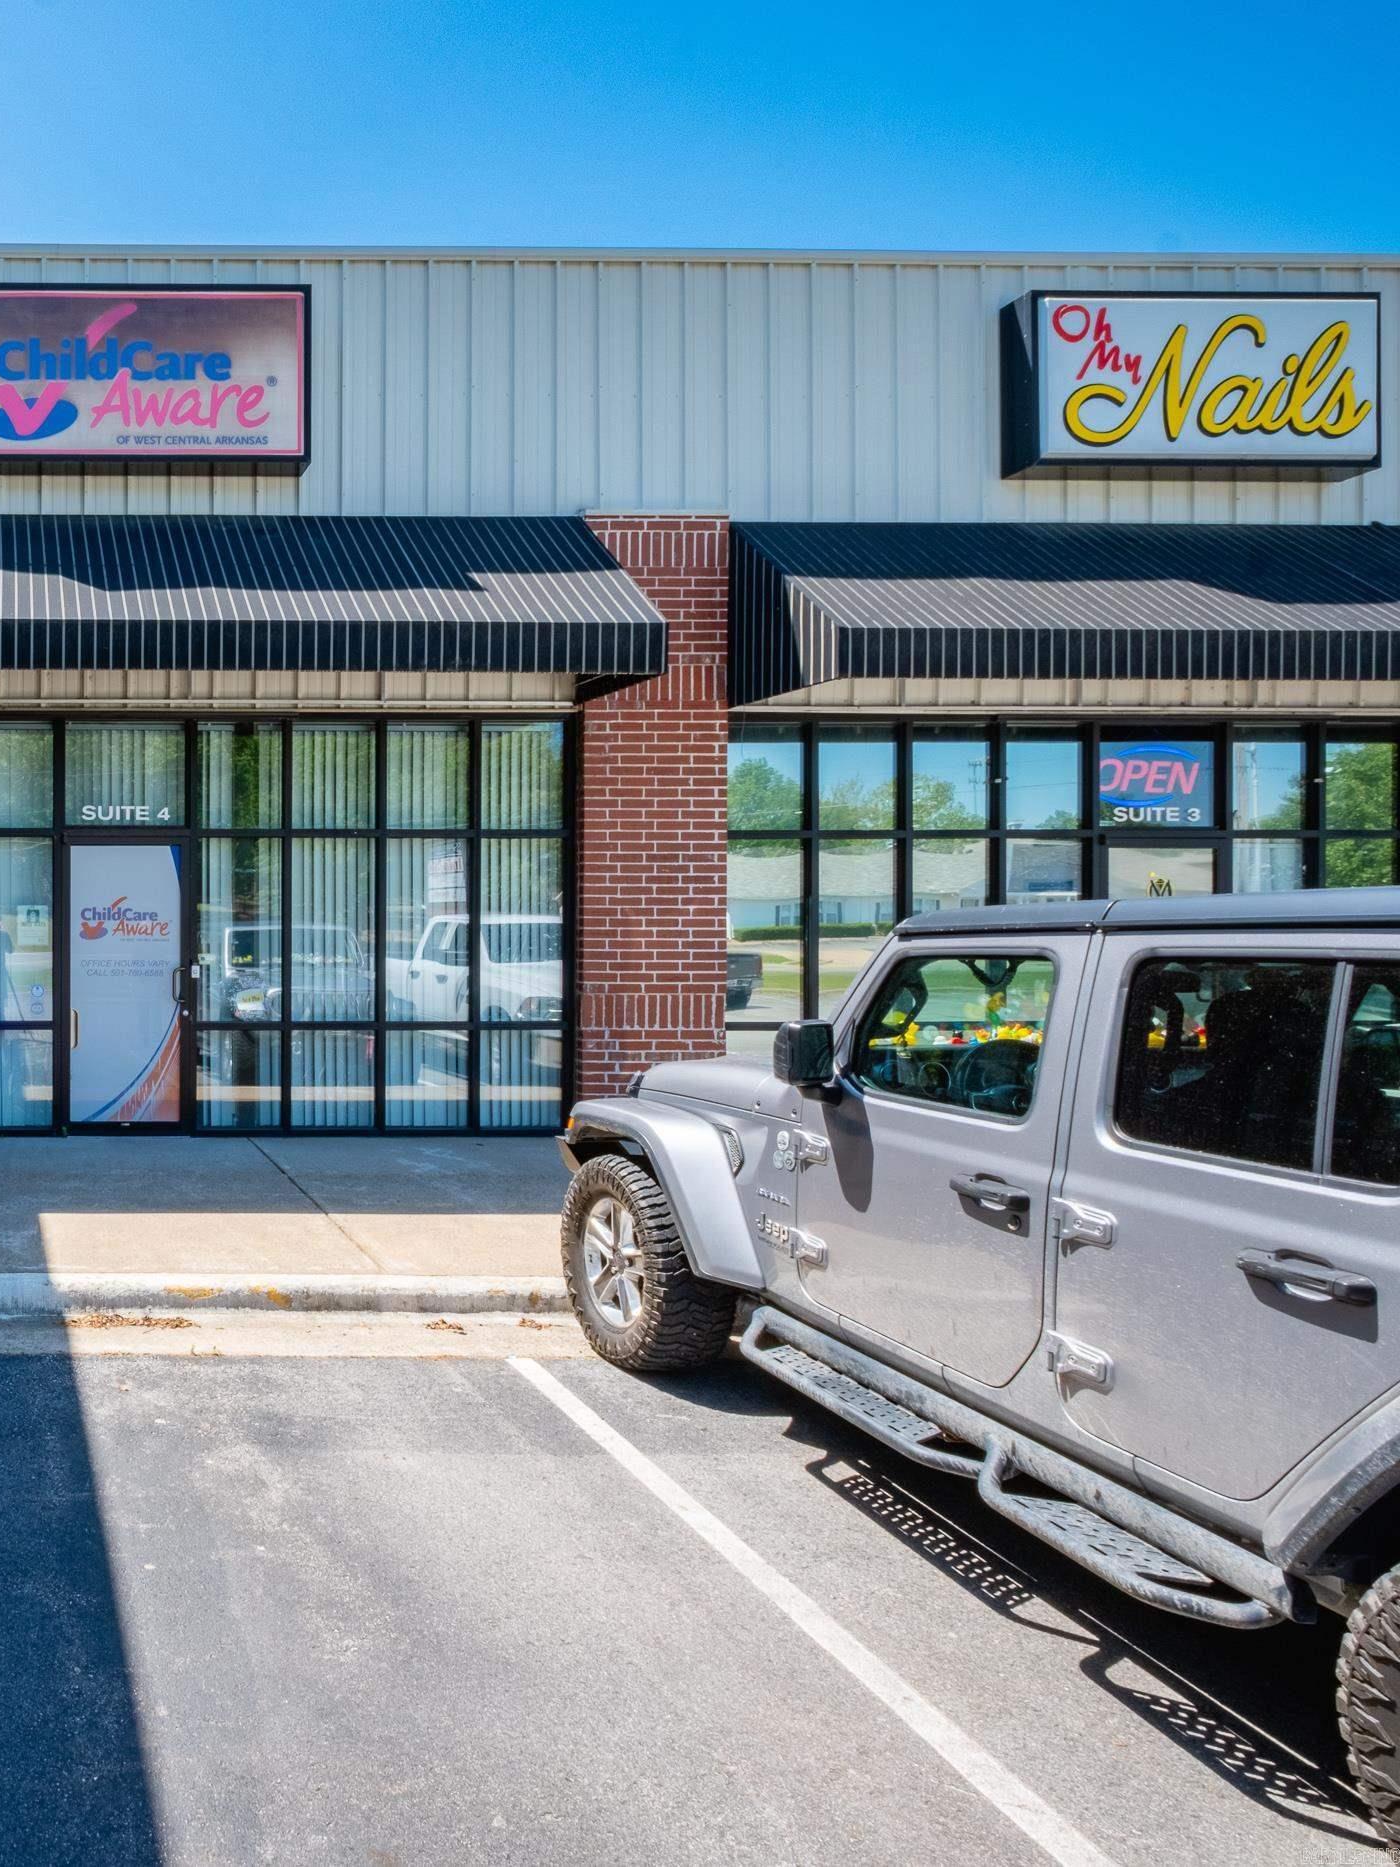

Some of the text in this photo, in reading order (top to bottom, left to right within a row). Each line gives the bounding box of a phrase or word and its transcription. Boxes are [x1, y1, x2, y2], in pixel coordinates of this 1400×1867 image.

[1052, 303, 1114, 343] Oh
[1075, 341, 1142, 385] My
[1063, 313, 1373, 447] Nails
[89, 367, 271, 430] Aware
[116, 435, 269, 446] OF WEST CENTRAL ARKANSAS
[1099, 758, 1200, 795] OPEN
[81, 804, 171, 821] SUITE 4
[1113, 806, 1201, 822] SUITE 3
[80, 906, 159, 921] ChildCare
[111, 918, 171, 937] Aware
[756, 1211, 789, 1243] Jeep
